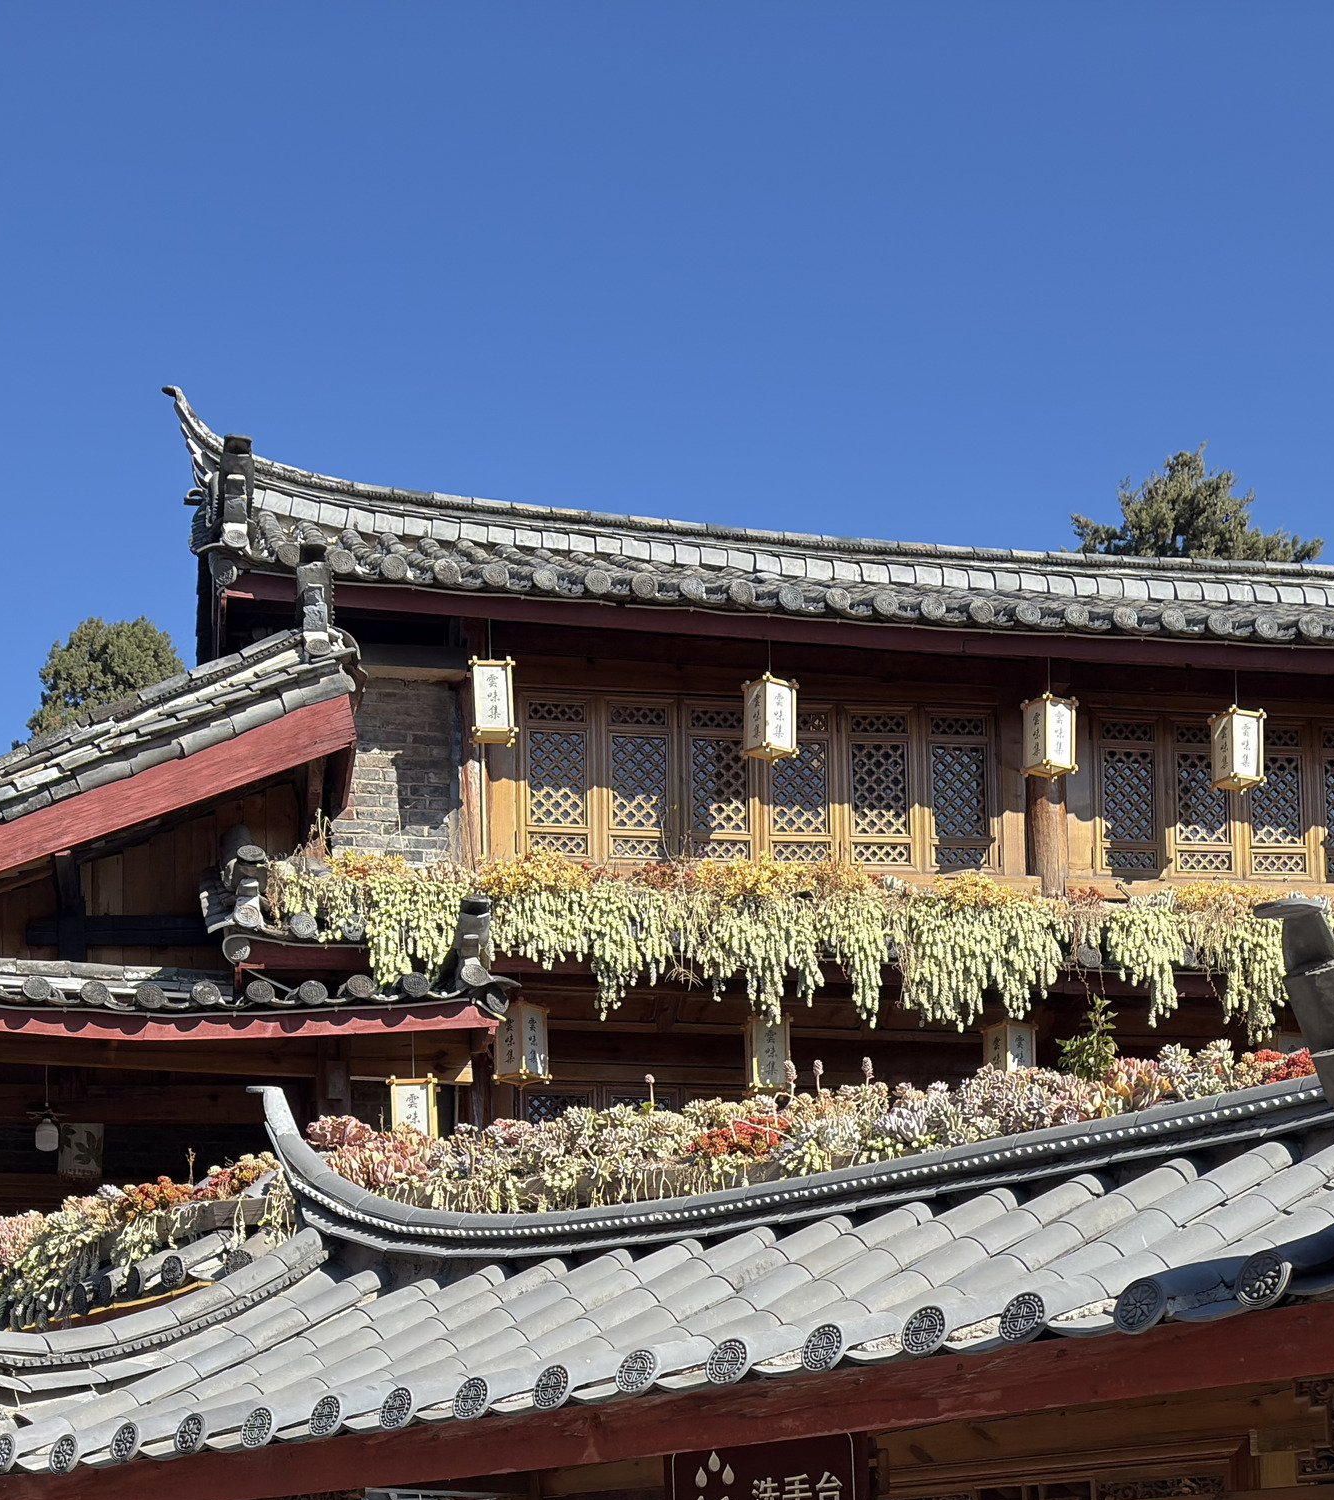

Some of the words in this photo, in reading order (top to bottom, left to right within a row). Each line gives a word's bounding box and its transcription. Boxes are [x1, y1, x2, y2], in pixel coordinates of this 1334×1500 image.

[487, 674, 501, 719] 雲味集
[505, 1017, 515, 1064] 雲味集
[528, 1017, 537, 1064] 雲味集
[765, 1030, 778, 1075] 雲味集
